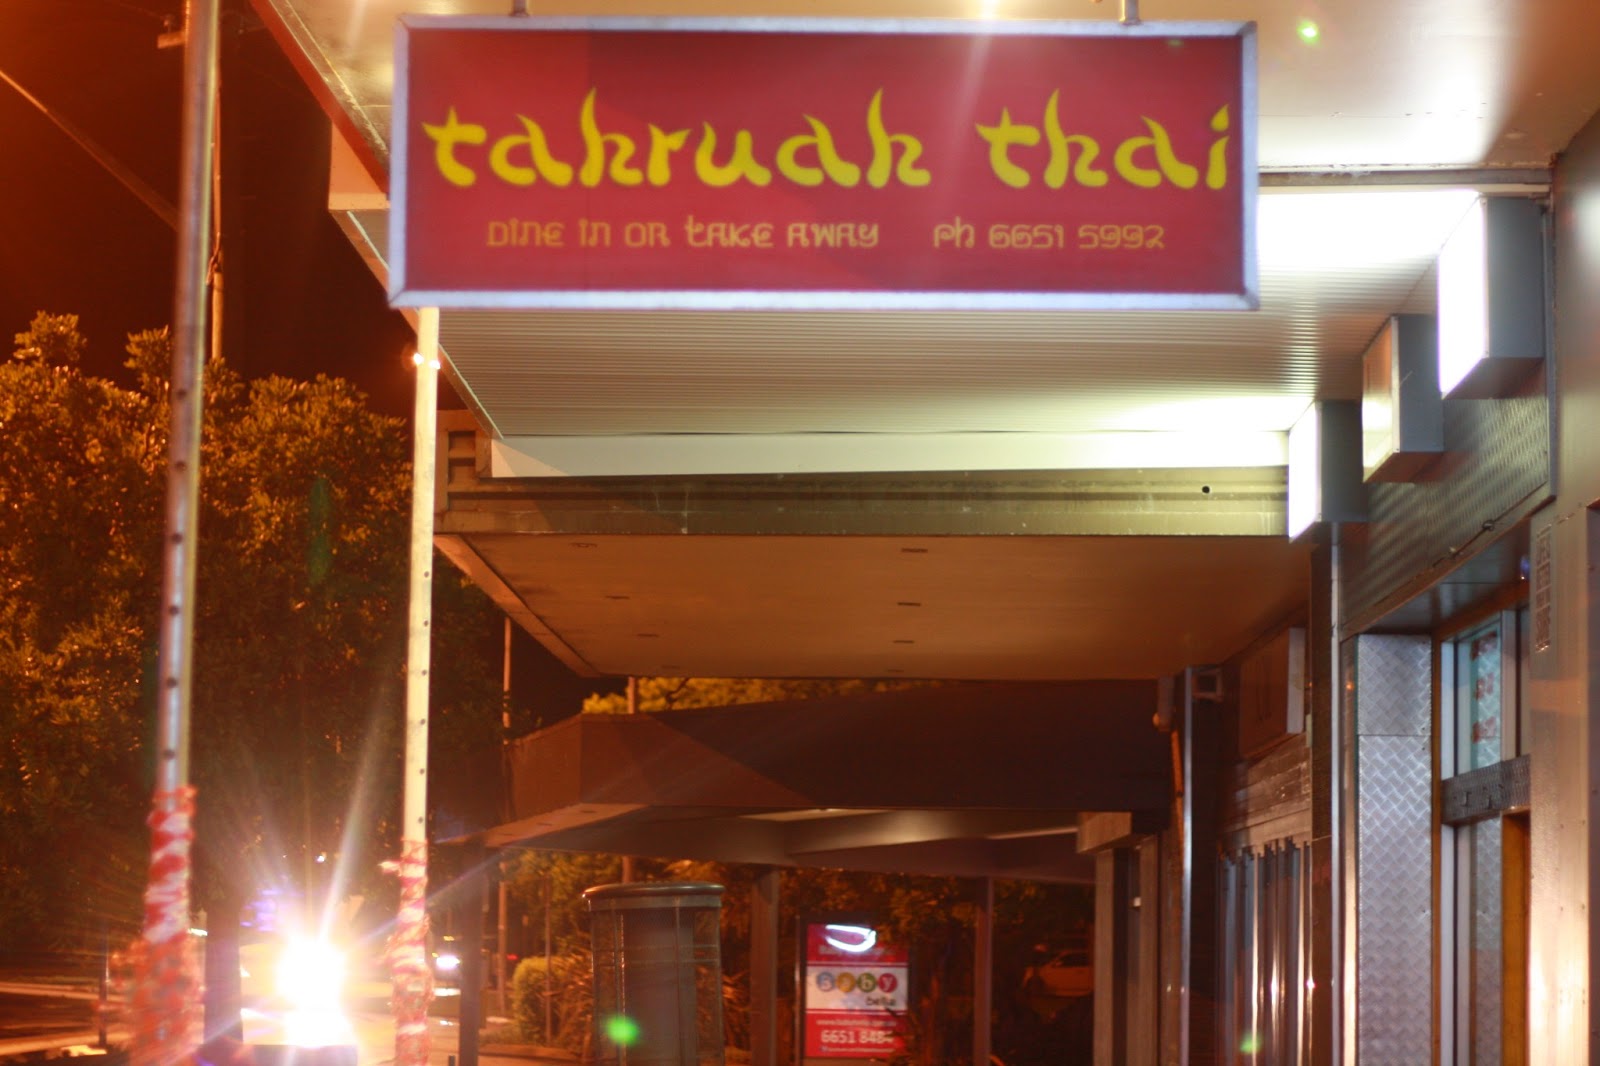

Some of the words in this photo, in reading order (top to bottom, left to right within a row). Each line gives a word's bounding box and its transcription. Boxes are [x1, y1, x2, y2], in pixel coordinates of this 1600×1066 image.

[422, 86, 932, 187] tahruah
[975, 88, 1229, 189] thai
[624, 221, 671, 247] OR
[989, 224, 1065, 249] 6651
[1078, 224, 1166, 249] 5992
[821, 1030, 856, 1044] 6651
